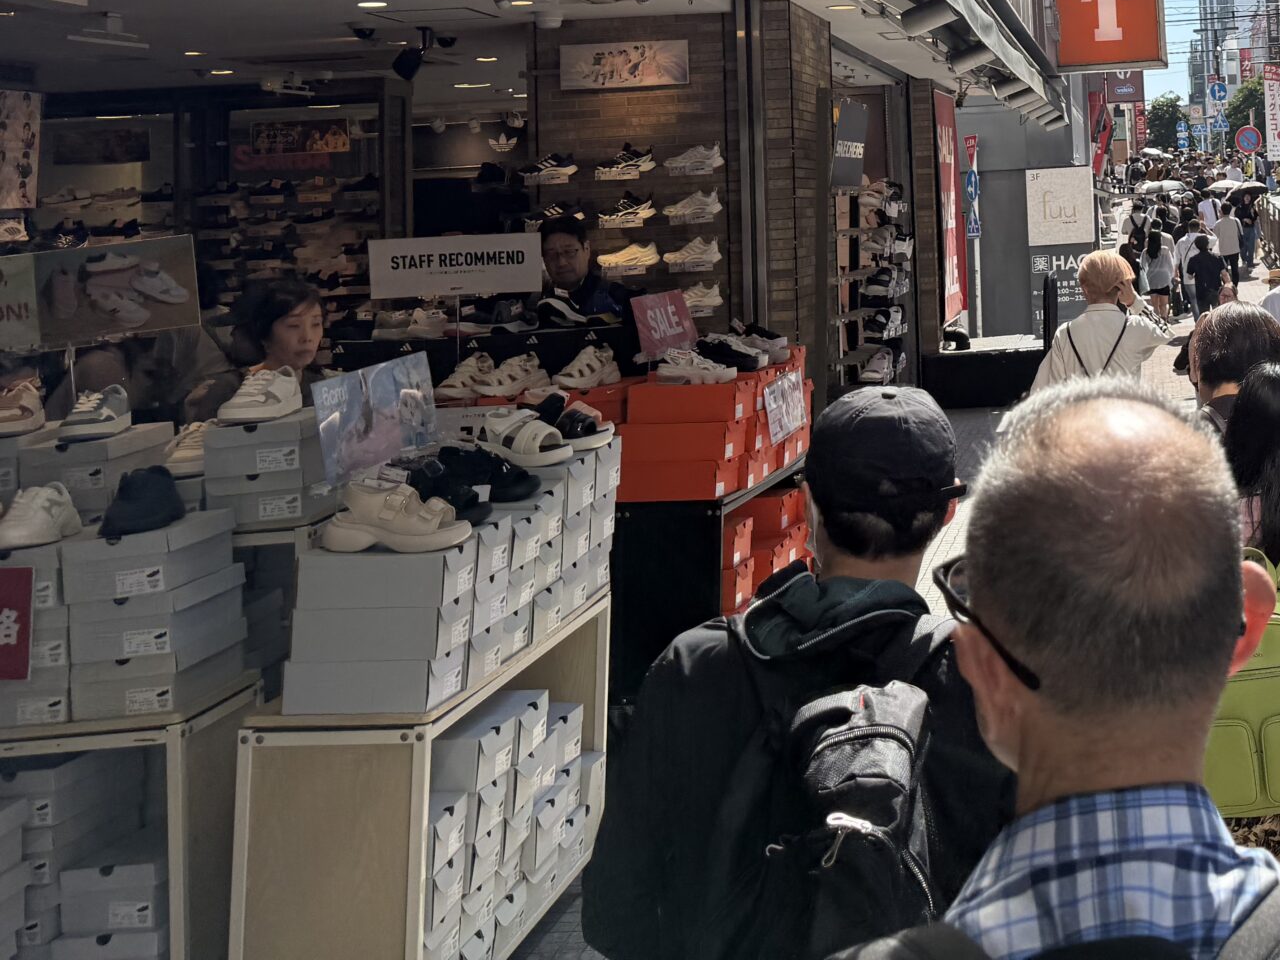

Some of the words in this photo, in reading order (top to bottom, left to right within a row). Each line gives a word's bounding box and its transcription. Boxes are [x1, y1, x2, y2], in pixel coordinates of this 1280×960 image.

[1268, 83, 1278, 142] ビッグエコー
[835, 140, 864, 159] SKECHERS
[937, 127, 953, 163] SALE
[1030, 173, 1041, 181] 3F
[1040, 191, 1077, 221] fuu
[391, 253, 434, 270] STAFF
[439, 250, 525, 268] RECOMMEND
[647, 304, 685, 340] SALE
